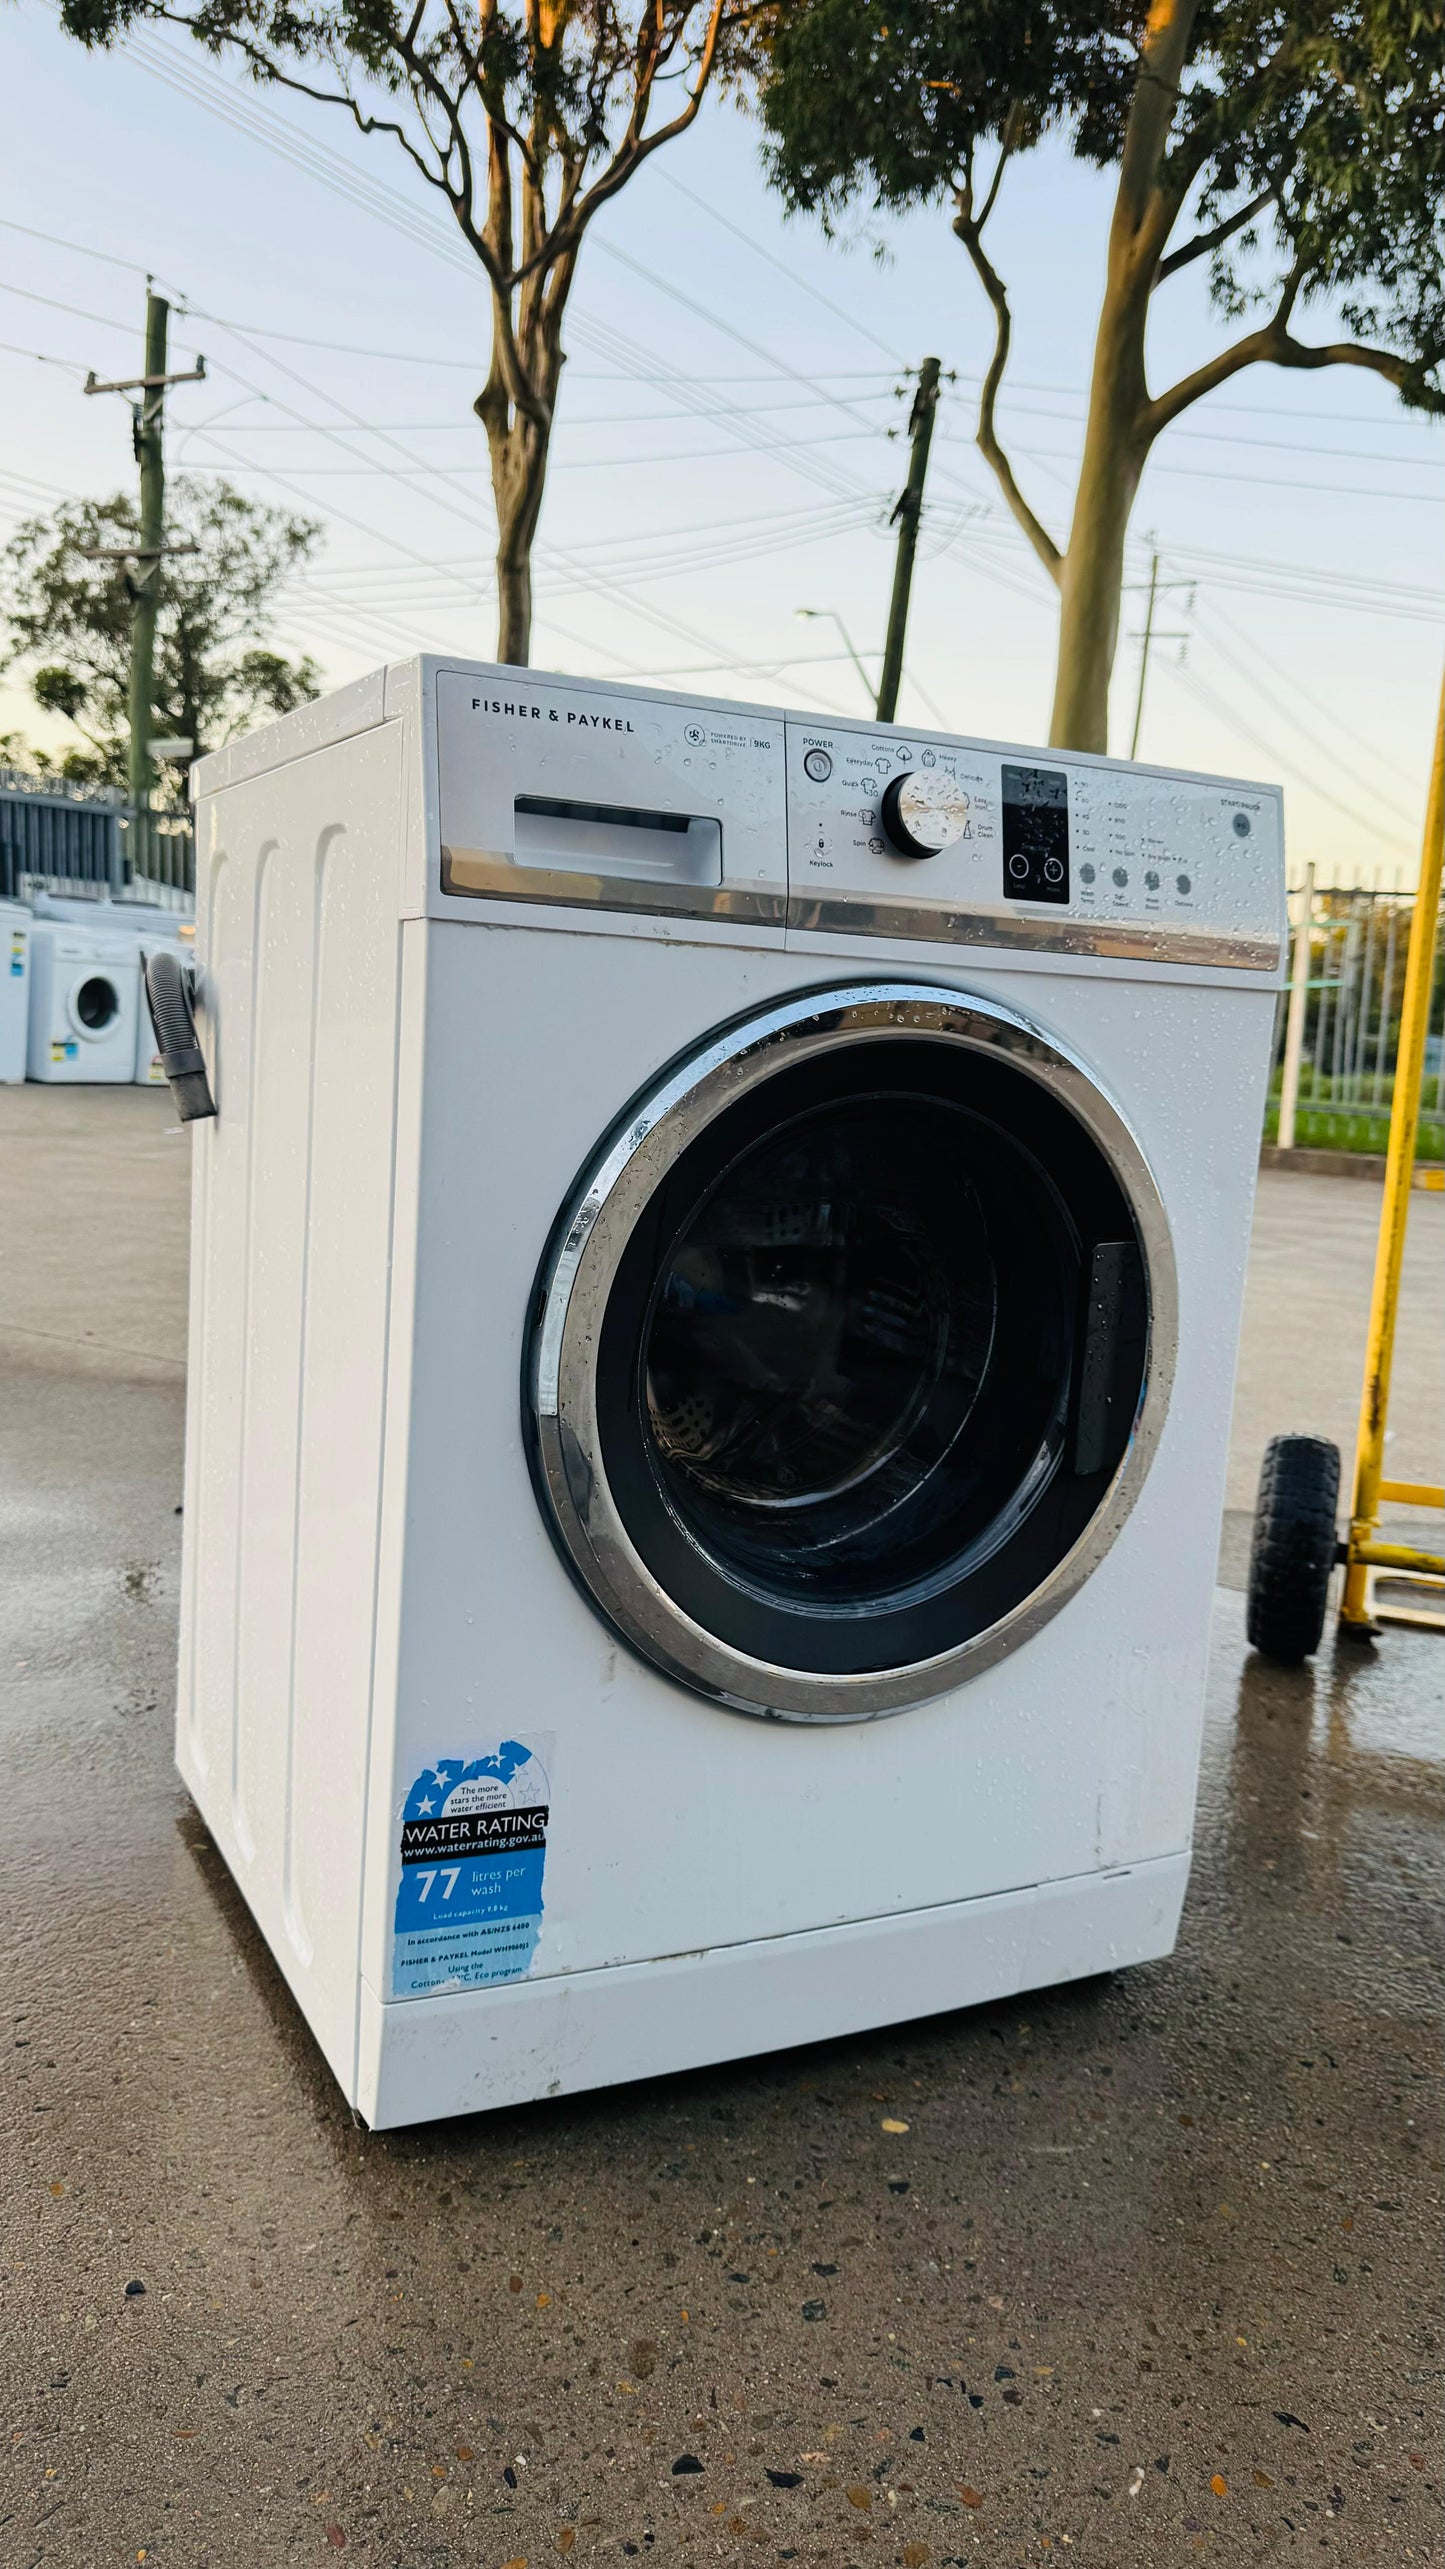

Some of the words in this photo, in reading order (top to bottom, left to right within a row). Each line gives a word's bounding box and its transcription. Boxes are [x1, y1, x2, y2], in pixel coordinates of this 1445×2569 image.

[472, 698, 541, 719] FISHER
[549, 709, 559, 722] &
[567, 712, 634, 733] PAYKEL
[753, 739, 771, 750] 9KG
[803, 737, 834, 749] POWER
[871, 744, 895, 753] Cottons
[846, 757, 874, 767] Everyday
[939, 754, 957, 763] Heavy
[841, 779, 859, 789] Quick
[840, 809, 857, 818] Rinse
[853, 839, 866, 847] Spin
[809, 859, 834, 868] Keylock
[461, 1786, 476, 1796] The
[477, 1785, 499, 1794] more
[450, 1795, 470, 1805] stars
[471, 1794, 485, 1803] the
[486, 1792, 507, 1801] more
[450, 1804, 473, 1814] water
[475, 1801, 507, 1812] efficient
[405, 1821, 471, 1844] WATER
[477, 1812, 546, 1836] RATING
[472, 1869, 501, 1883] litres
[505, 1866, 526, 1882] per
[416, 1866, 462, 1904] 77
[471, 1882, 501, 1897] wash
[433, 1911, 453, 1920] Load
[454, 1907, 485, 1918] capacity
[499, 1903, 509, 1912] kg
[407, 1938, 416, 1946] In
[417, 1933, 460, 1945] accordance
[462, 1929, 479, 1939] with
[480, 1924, 511, 1936] AS/NZS
[400, 1956, 429, 1967] FISHER
[430, 1955, 437, 1963] &
[438, 1951, 469, 1962] PAYKEL
[470, 1948, 493, 1958] Model
[448, 1964, 469, 1975] Using
[471, 1962, 484, 1971] the
[474, 1971, 490, 1981] Eco
[491, 1967, 523, 1979] program
